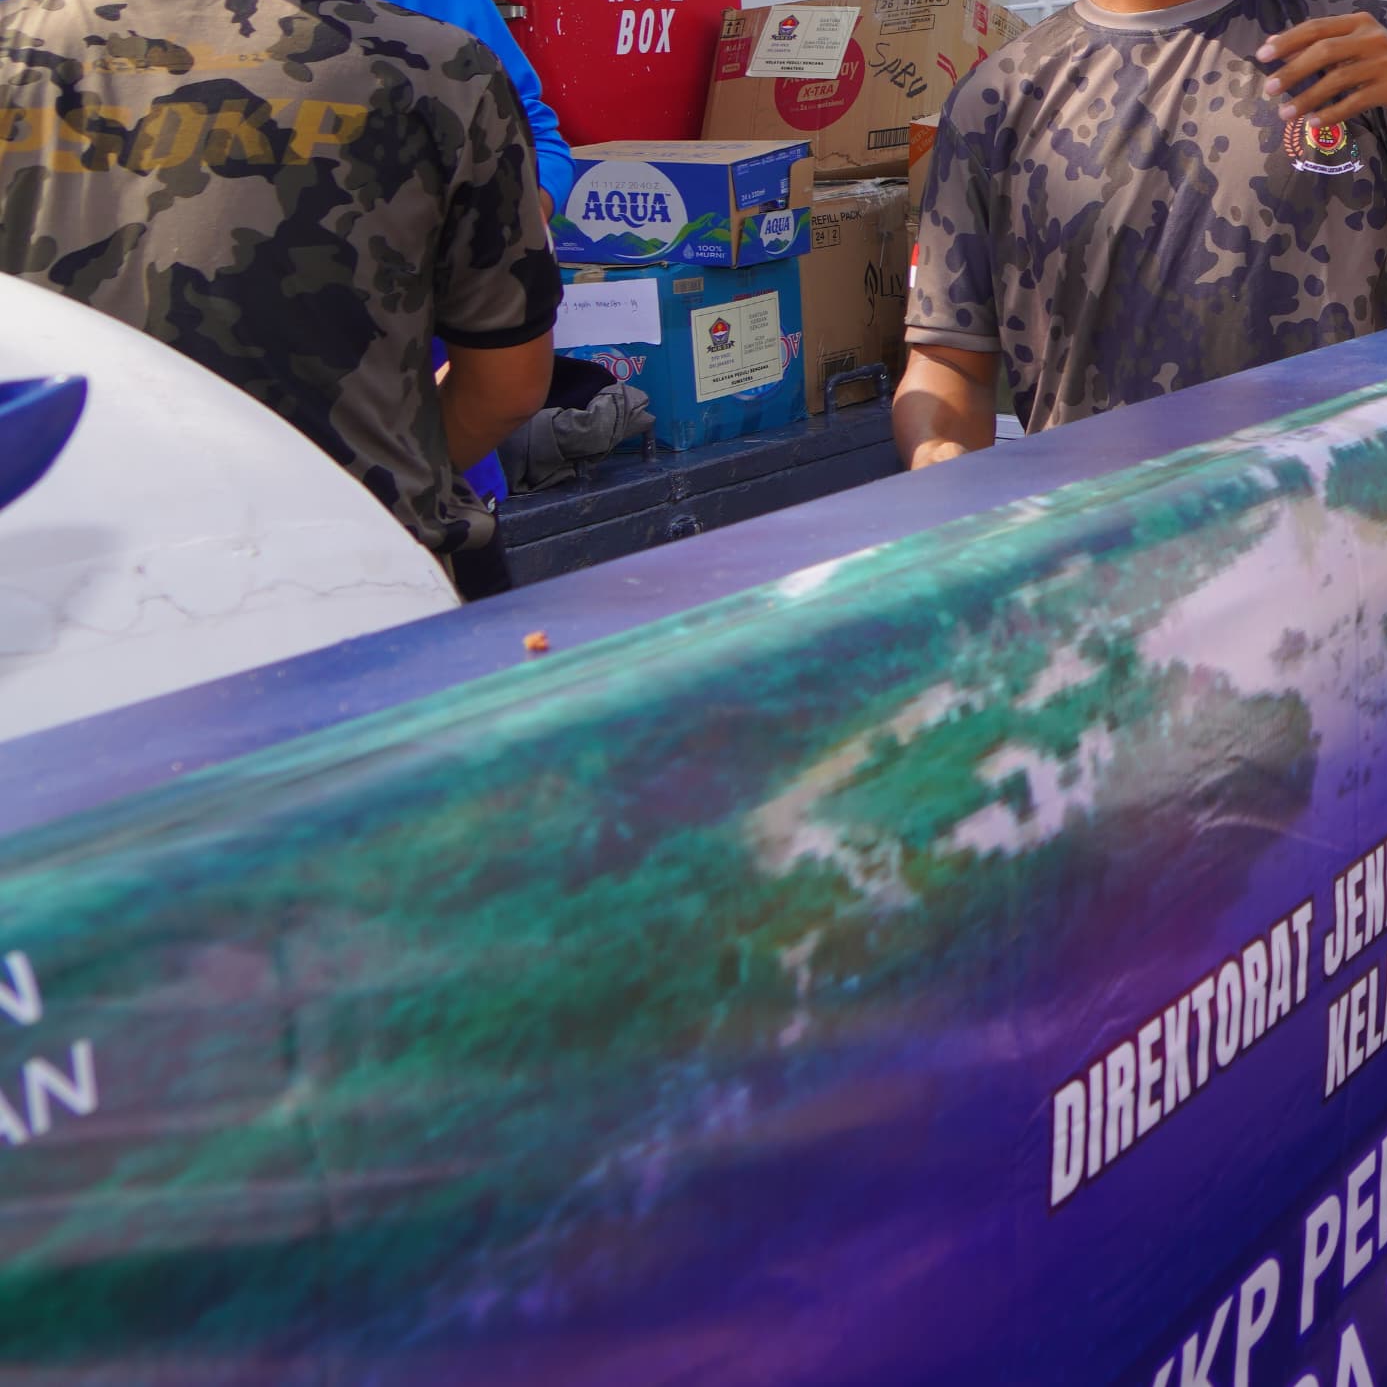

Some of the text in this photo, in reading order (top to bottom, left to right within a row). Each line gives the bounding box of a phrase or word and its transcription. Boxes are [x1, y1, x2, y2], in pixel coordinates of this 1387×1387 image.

[616, 8, 676, 55] BOX
[802, 84, 834, 98] X-TRA
[582, 190, 672, 229] AQUA
[811, 210, 862, 226] REFILL PACK
[765, 217, 790, 235] AQUA
[815, 231, 825, 242] 24
[1051, 903, 1312, 1207] DIREKTORAT
